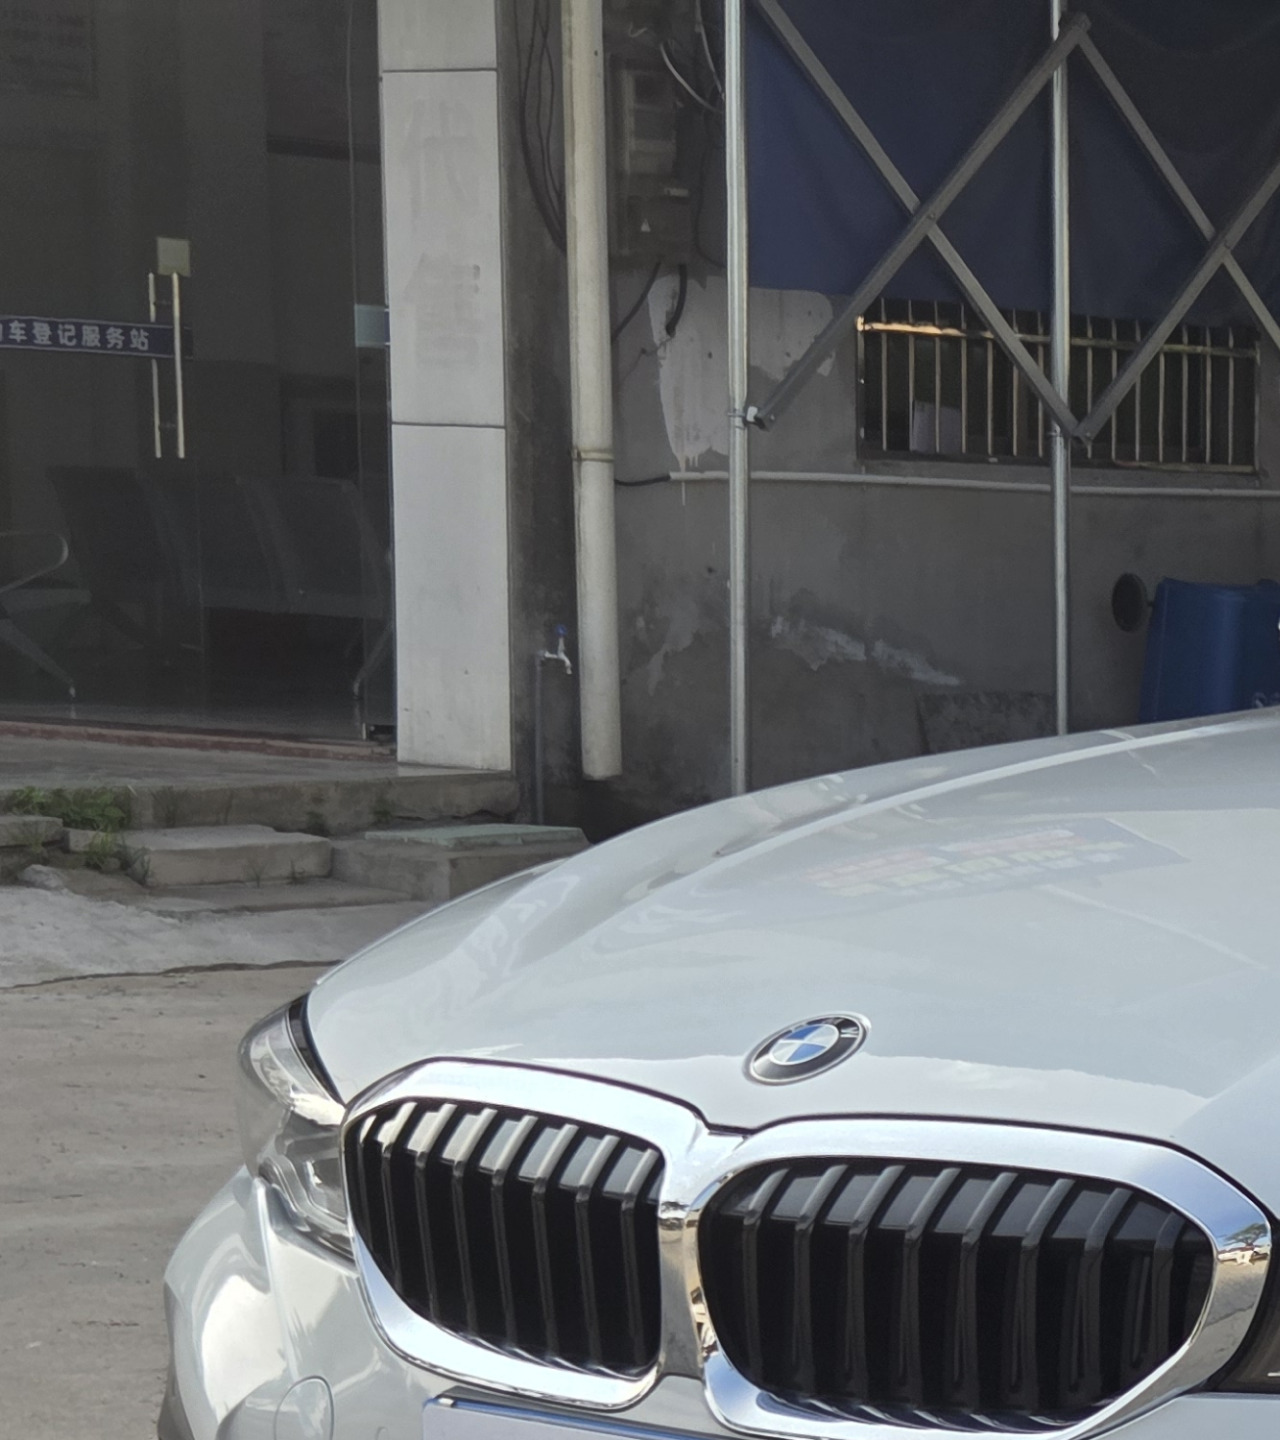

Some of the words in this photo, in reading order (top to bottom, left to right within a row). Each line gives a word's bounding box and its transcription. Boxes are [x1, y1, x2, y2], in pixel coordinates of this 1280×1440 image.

[0, 320, 149, 351] 车登记服务站
